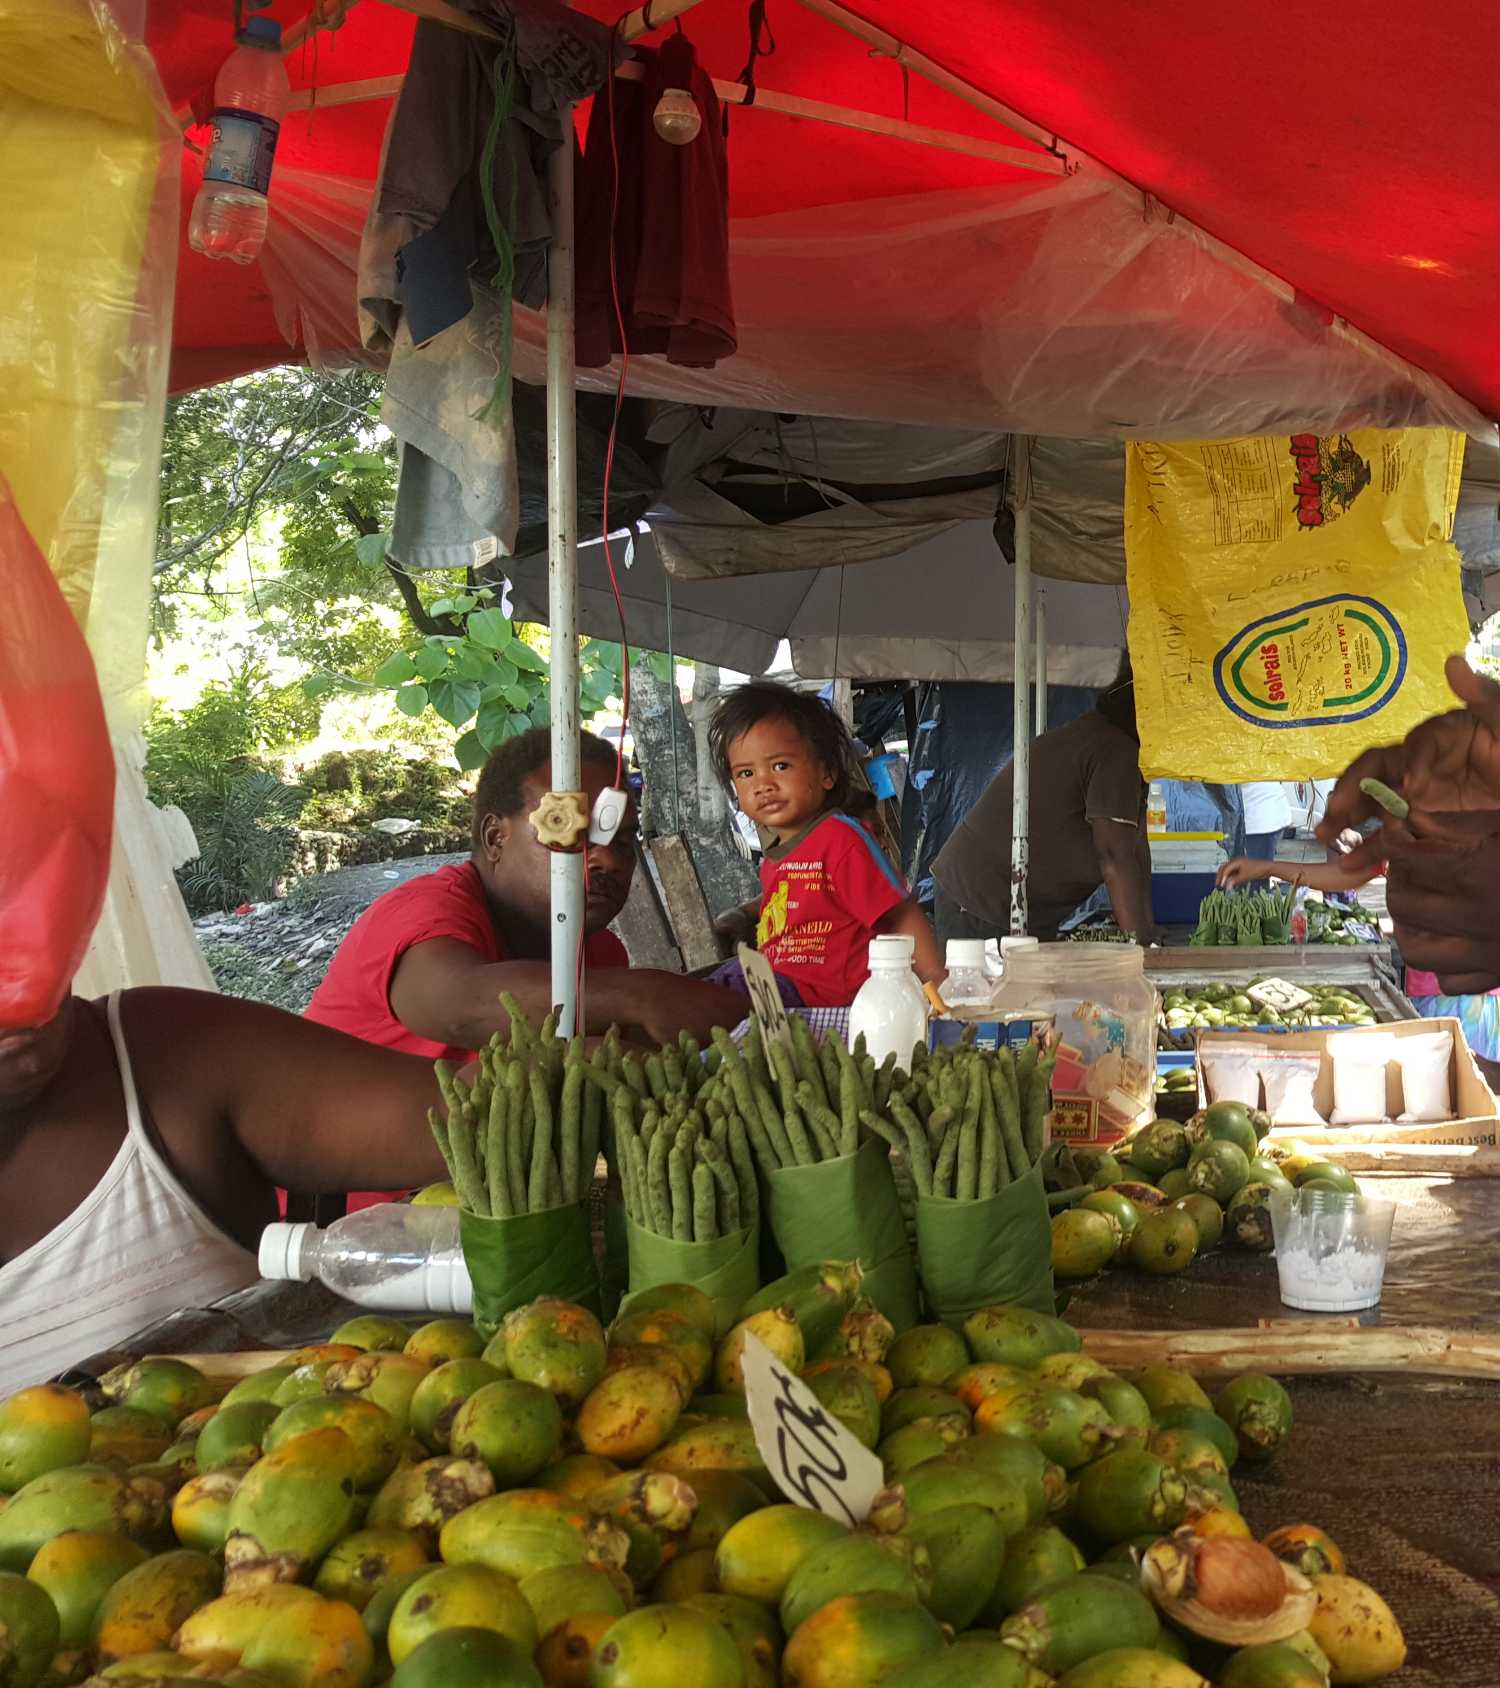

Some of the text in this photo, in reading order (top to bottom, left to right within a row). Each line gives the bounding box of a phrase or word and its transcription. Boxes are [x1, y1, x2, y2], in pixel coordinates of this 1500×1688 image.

[1336, 623, 1346, 637] WT
[1259, 643, 1286, 702] solrais
[1344, 677, 1353, 690] 20
[1467, 1134, 1497, 1146] Best
